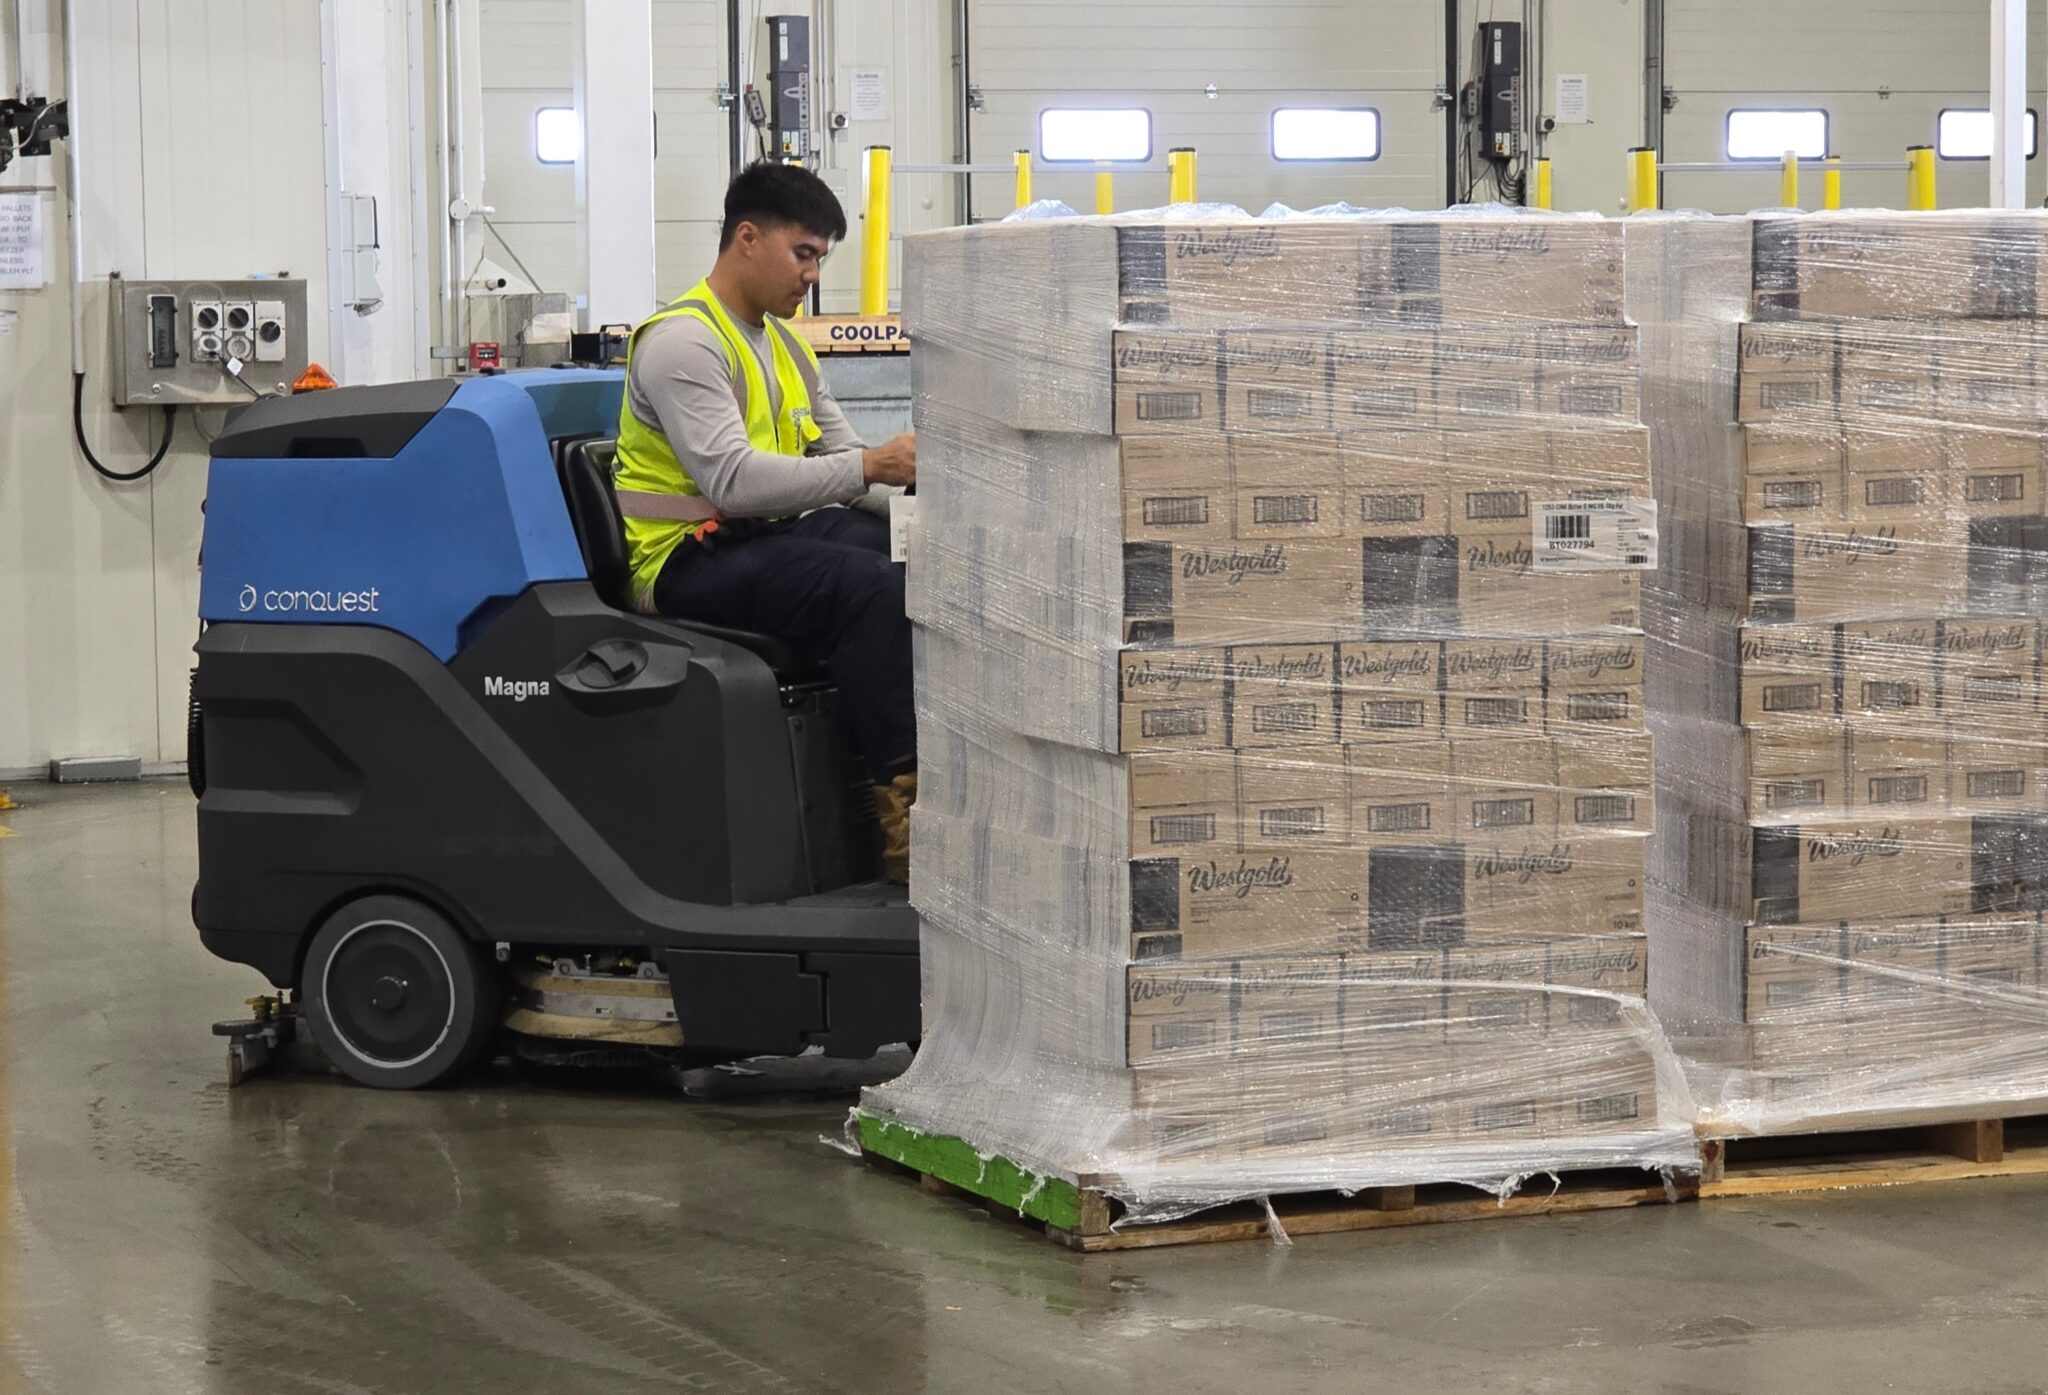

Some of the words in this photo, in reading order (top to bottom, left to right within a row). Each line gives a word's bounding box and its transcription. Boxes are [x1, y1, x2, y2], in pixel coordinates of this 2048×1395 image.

[1549, 540, 1595, 550] BT027794
[1804, 526, 1900, 565] Westgold
[1181, 544, 1287, 585] Westgold
[264, 587, 379, 612] conquest
[1947, 626, 2026, 654] Westgold
[1125, 659, 1216, 691] Westgold
[1236, 652, 1324, 687] Westgold
[1343, 650, 1431, 683] Westgold
[1449, 647, 1535, 678] Westgold
[1552, 645, 1636, 678] Westgold
[485, 676, 549, 701] Magna
[1807, 827, 1902, 866] Westgold
[1188, 856, 1293, 898] Westgold
[1473, 845, 1573, 884] Westgold
[1613, 920, 1623, 929] 10
[1130, 970, 1220, 1006] Westgold
